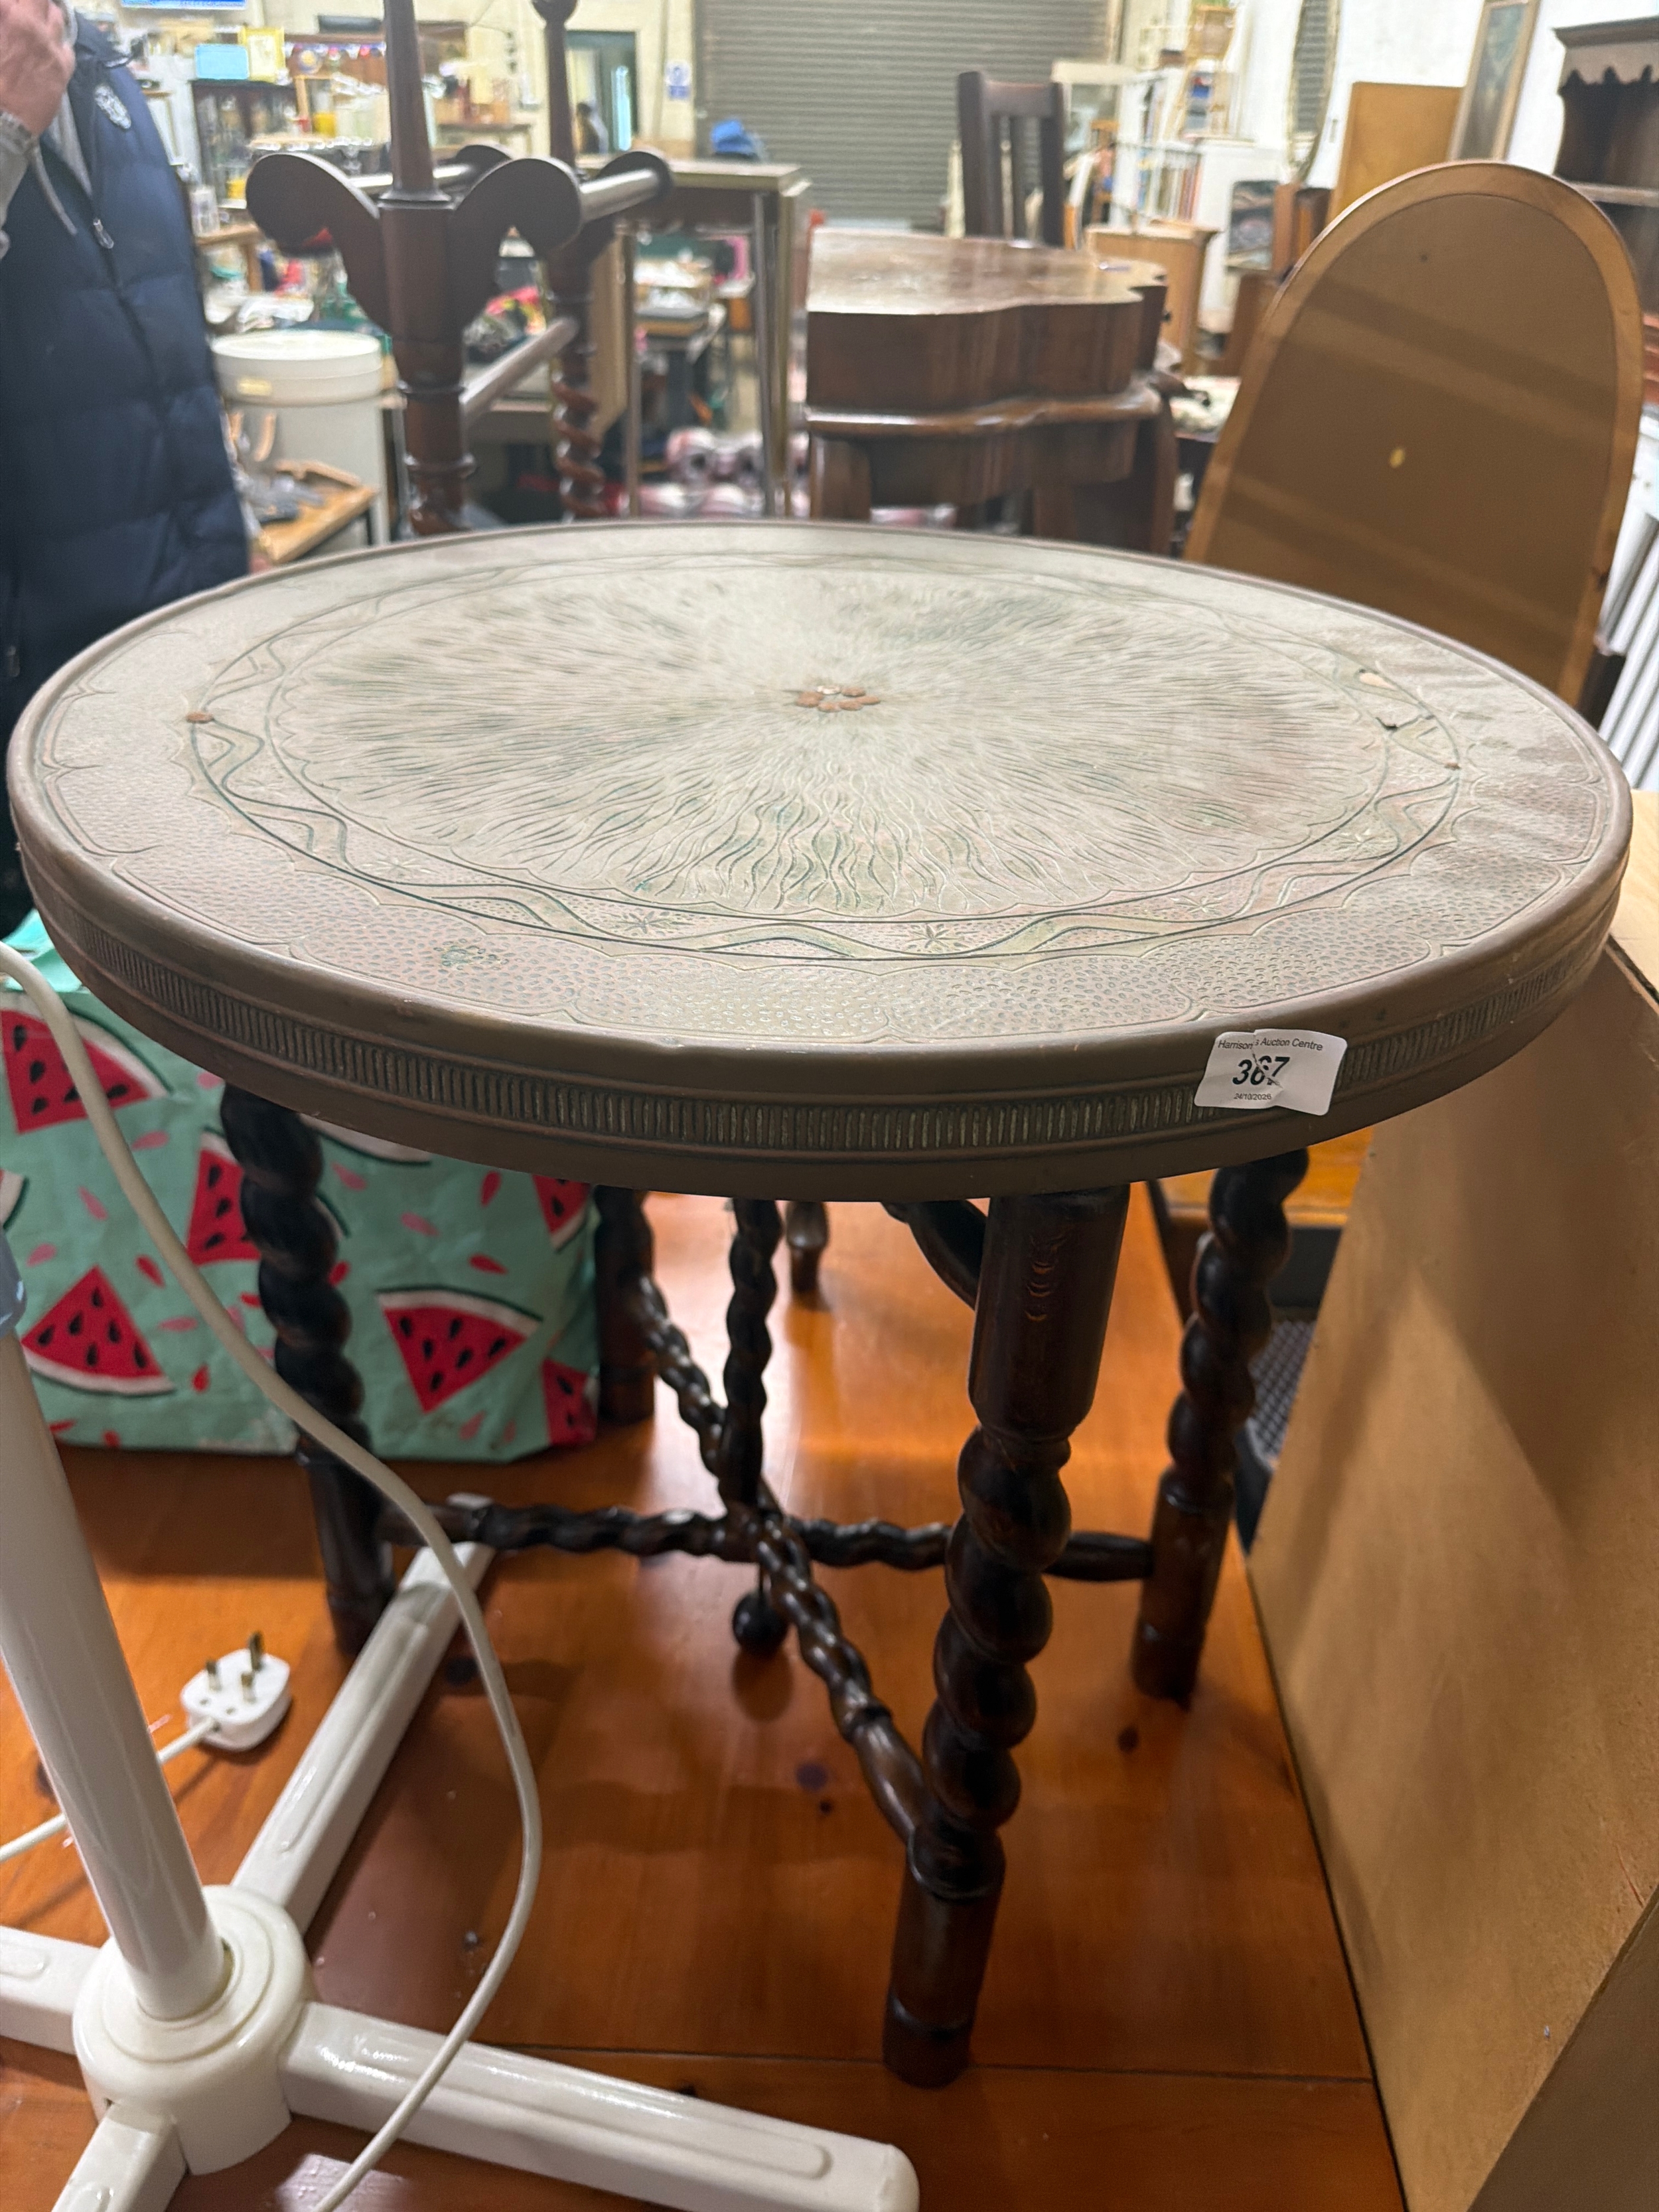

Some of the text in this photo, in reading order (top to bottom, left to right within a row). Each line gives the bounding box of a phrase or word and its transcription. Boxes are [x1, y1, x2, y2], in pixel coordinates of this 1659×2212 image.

[1260, 1037, 1291, 1047] Auction
[1291, 1038, 1323, 1051] Centre
[1232, 1055, 1290, 1085] 367
